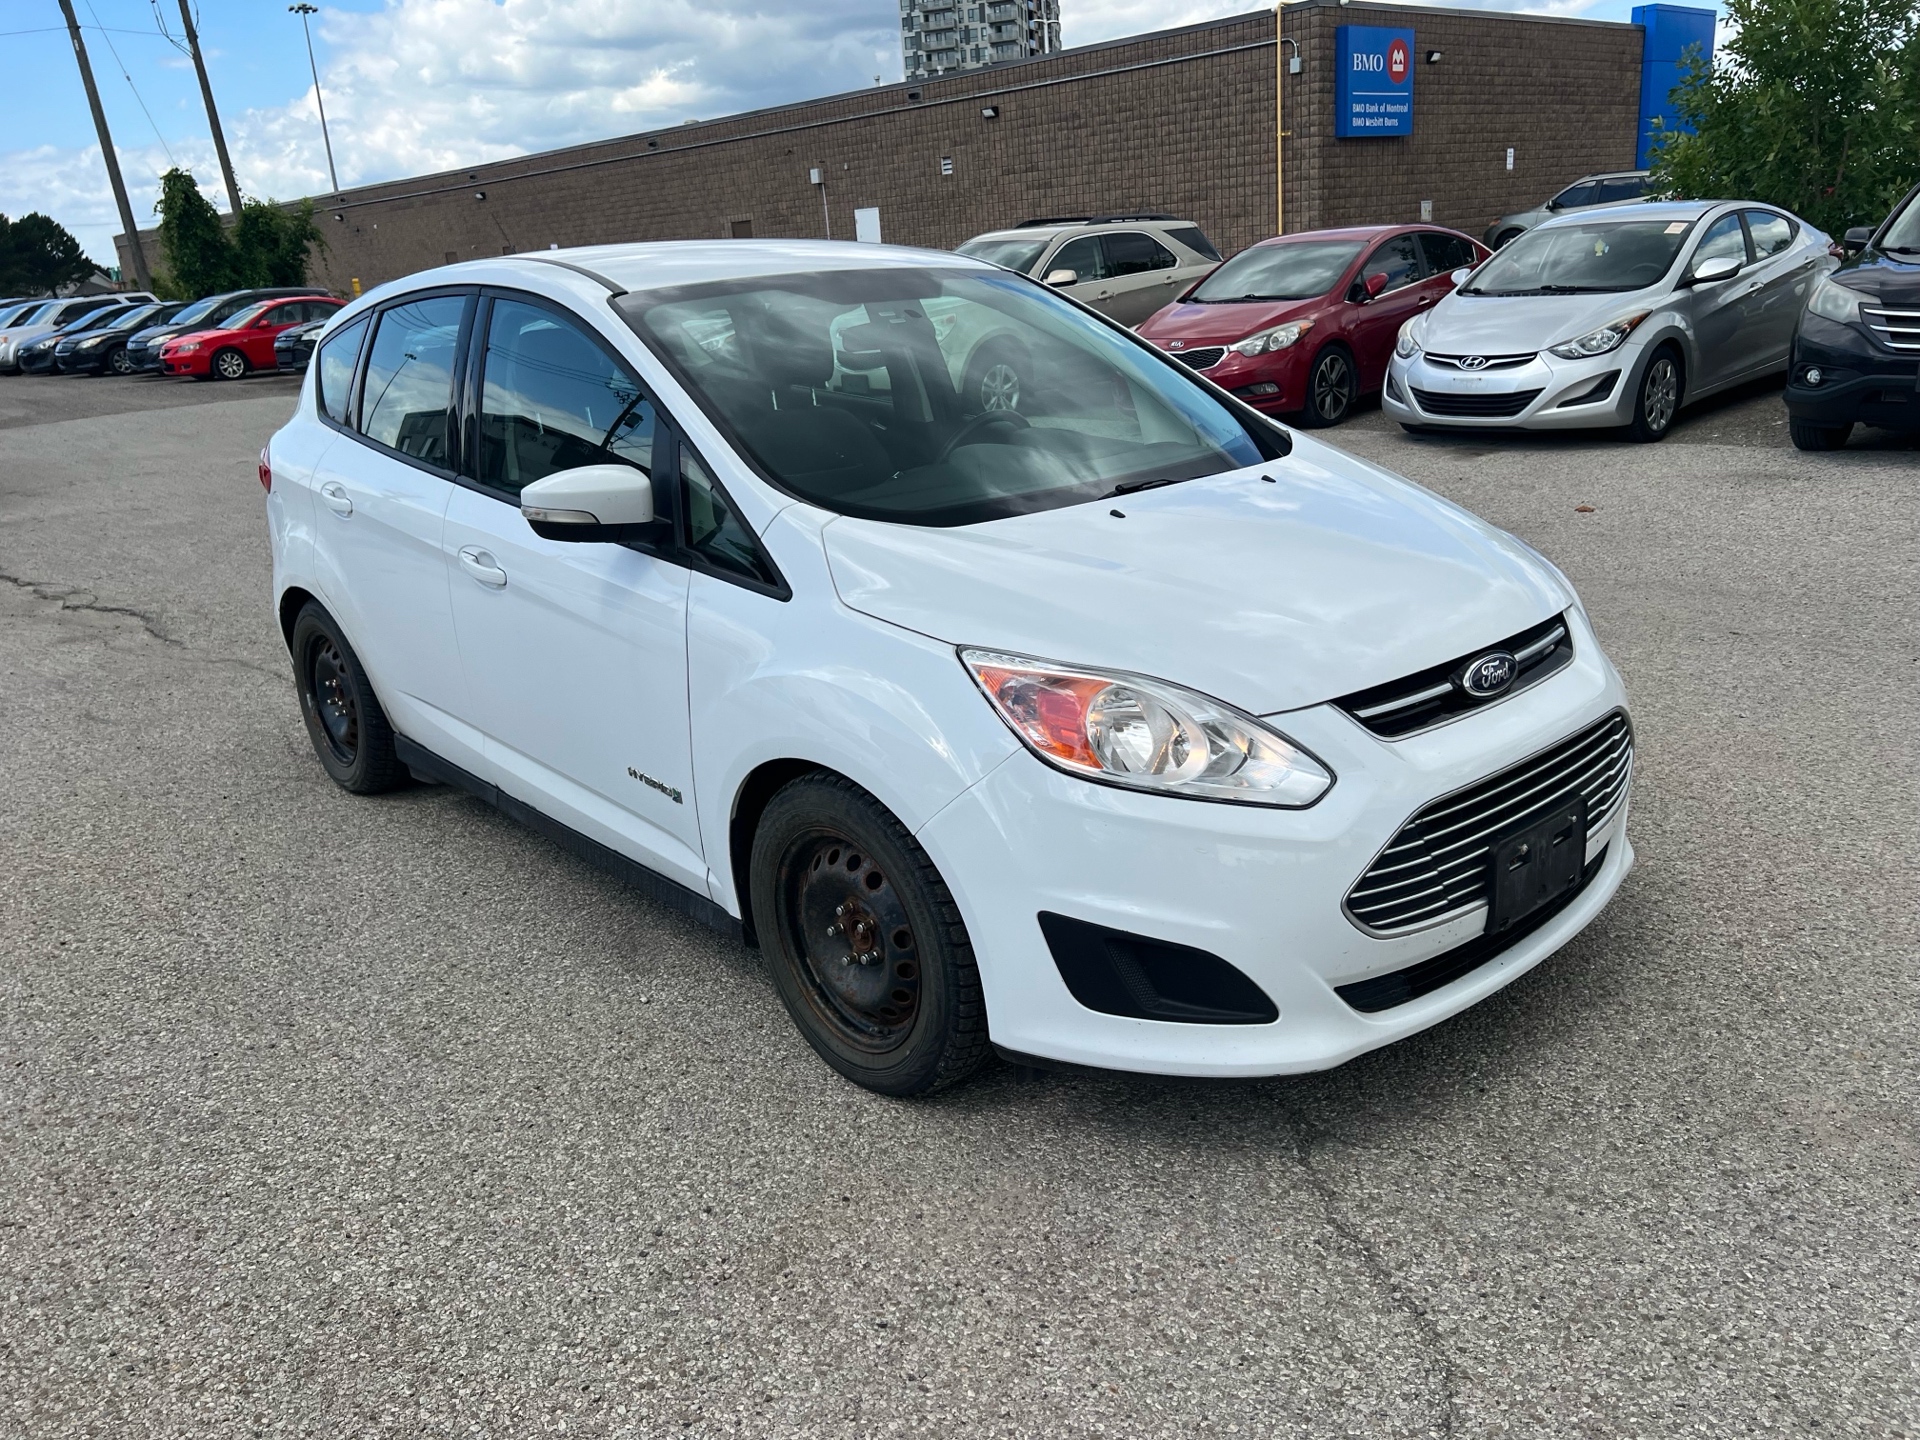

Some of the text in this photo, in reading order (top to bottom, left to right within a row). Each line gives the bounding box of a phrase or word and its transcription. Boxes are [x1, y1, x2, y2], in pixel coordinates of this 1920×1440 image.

[1352, 53, 1384, 72] BMO
[1352, 102, 1409, 113] BMO Bank of Montreal
[1352, 116, 1399, 127] BMO Nesbitt Burns
[1481, 660, 1511, 688] Ford
